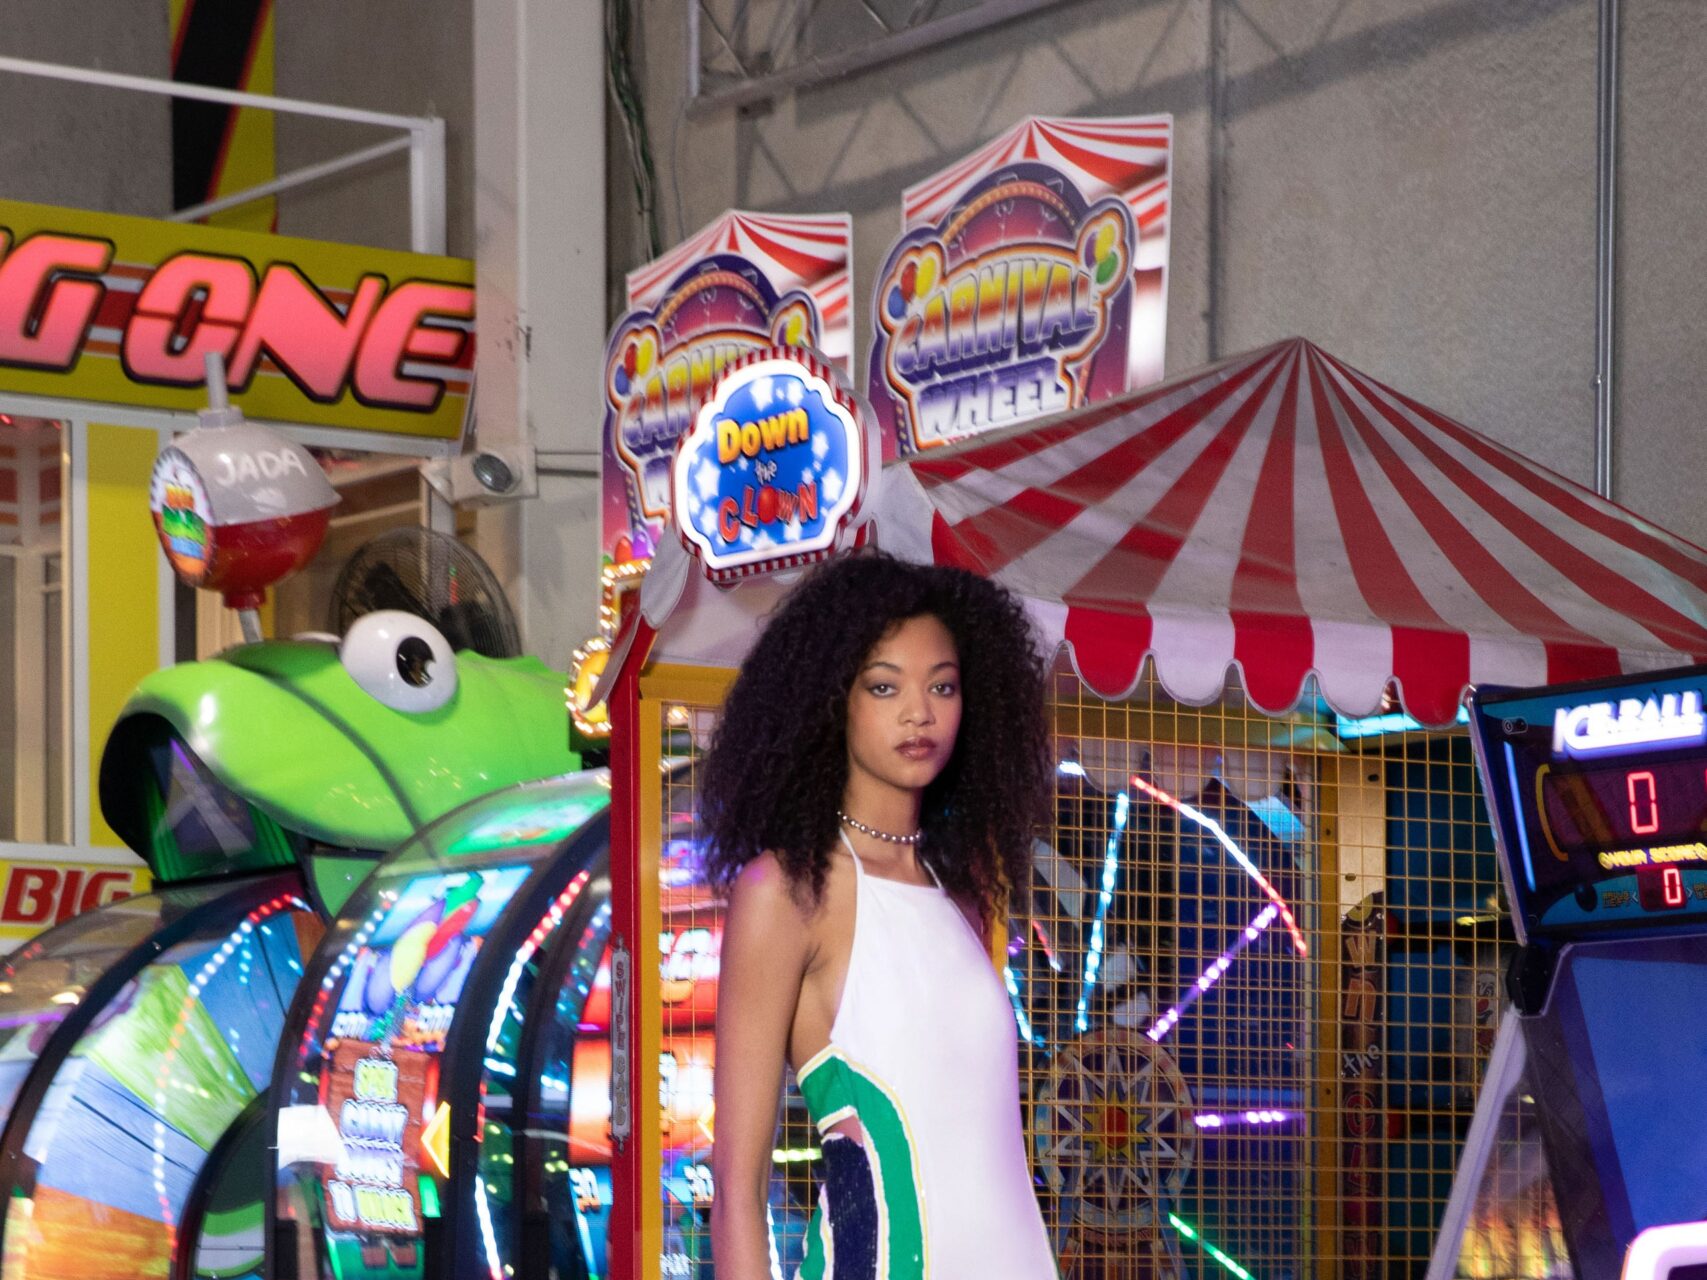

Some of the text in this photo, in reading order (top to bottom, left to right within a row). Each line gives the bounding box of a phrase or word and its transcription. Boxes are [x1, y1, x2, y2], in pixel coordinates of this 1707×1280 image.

[121, 251, 476, 413] ONE
[895, 256, 1098, 380] CARNIVAL
[917, 356, 1070, 440] WHEEL
[213, 450, 309, 488] JADA
[718, 481, 818, 543] CLOWN
[1627, 771, 1659, 835] 0
[0, 866, 134, 926] BIG
[1663, 868, 1683, 905] 0
[614, 960, 627, 1050] SWIPE
